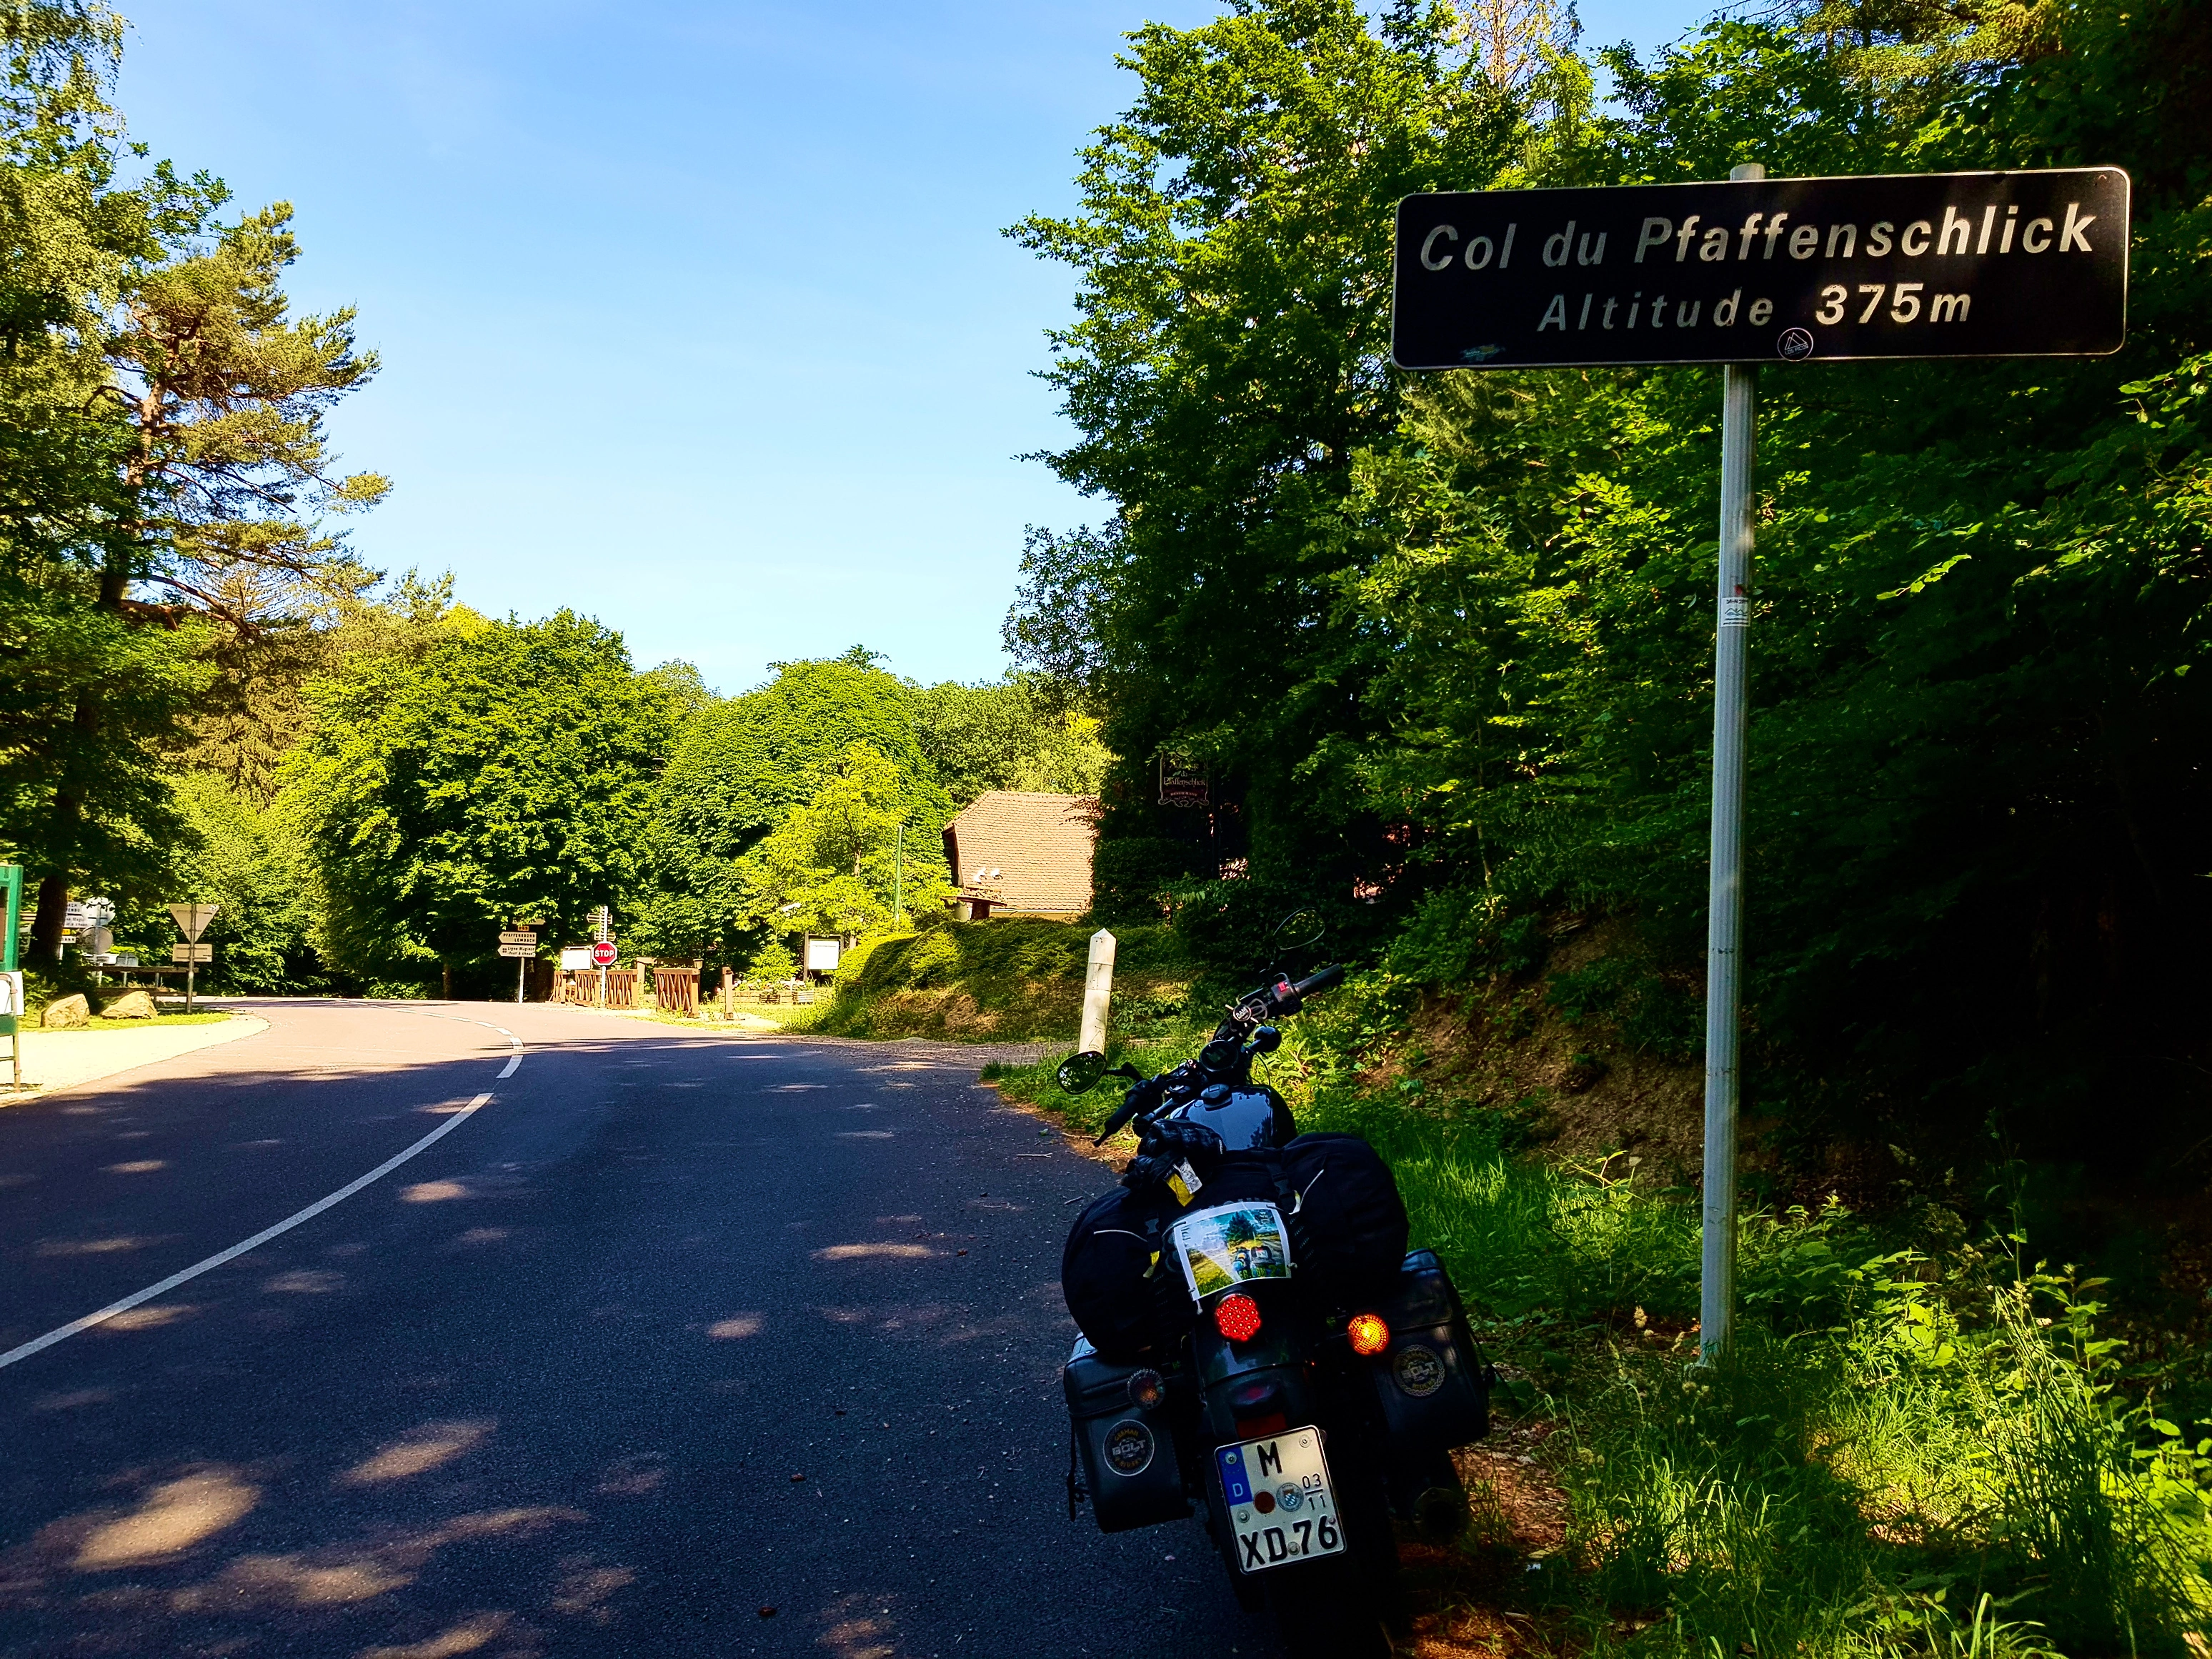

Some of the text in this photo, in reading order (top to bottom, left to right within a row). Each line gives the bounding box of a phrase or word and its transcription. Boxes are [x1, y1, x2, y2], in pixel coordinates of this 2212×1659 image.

[1420, 202, 2098, 271] Col du Pfaffenschlick
[1536, 282, 1972, 332] Altitude 375m
[594, 950, 614, 958] STOP
[1401, 1361, 1435, 1379] BOLT
[1112, 1439, 1146, 1456] BOLT
[1256, 1440, 1282, 1478] M
[1302, 1473, 1322, 1490] 03
[1232, 1483, 1243, 1498] D
[1307, 1494, 1327, 1511] 11
